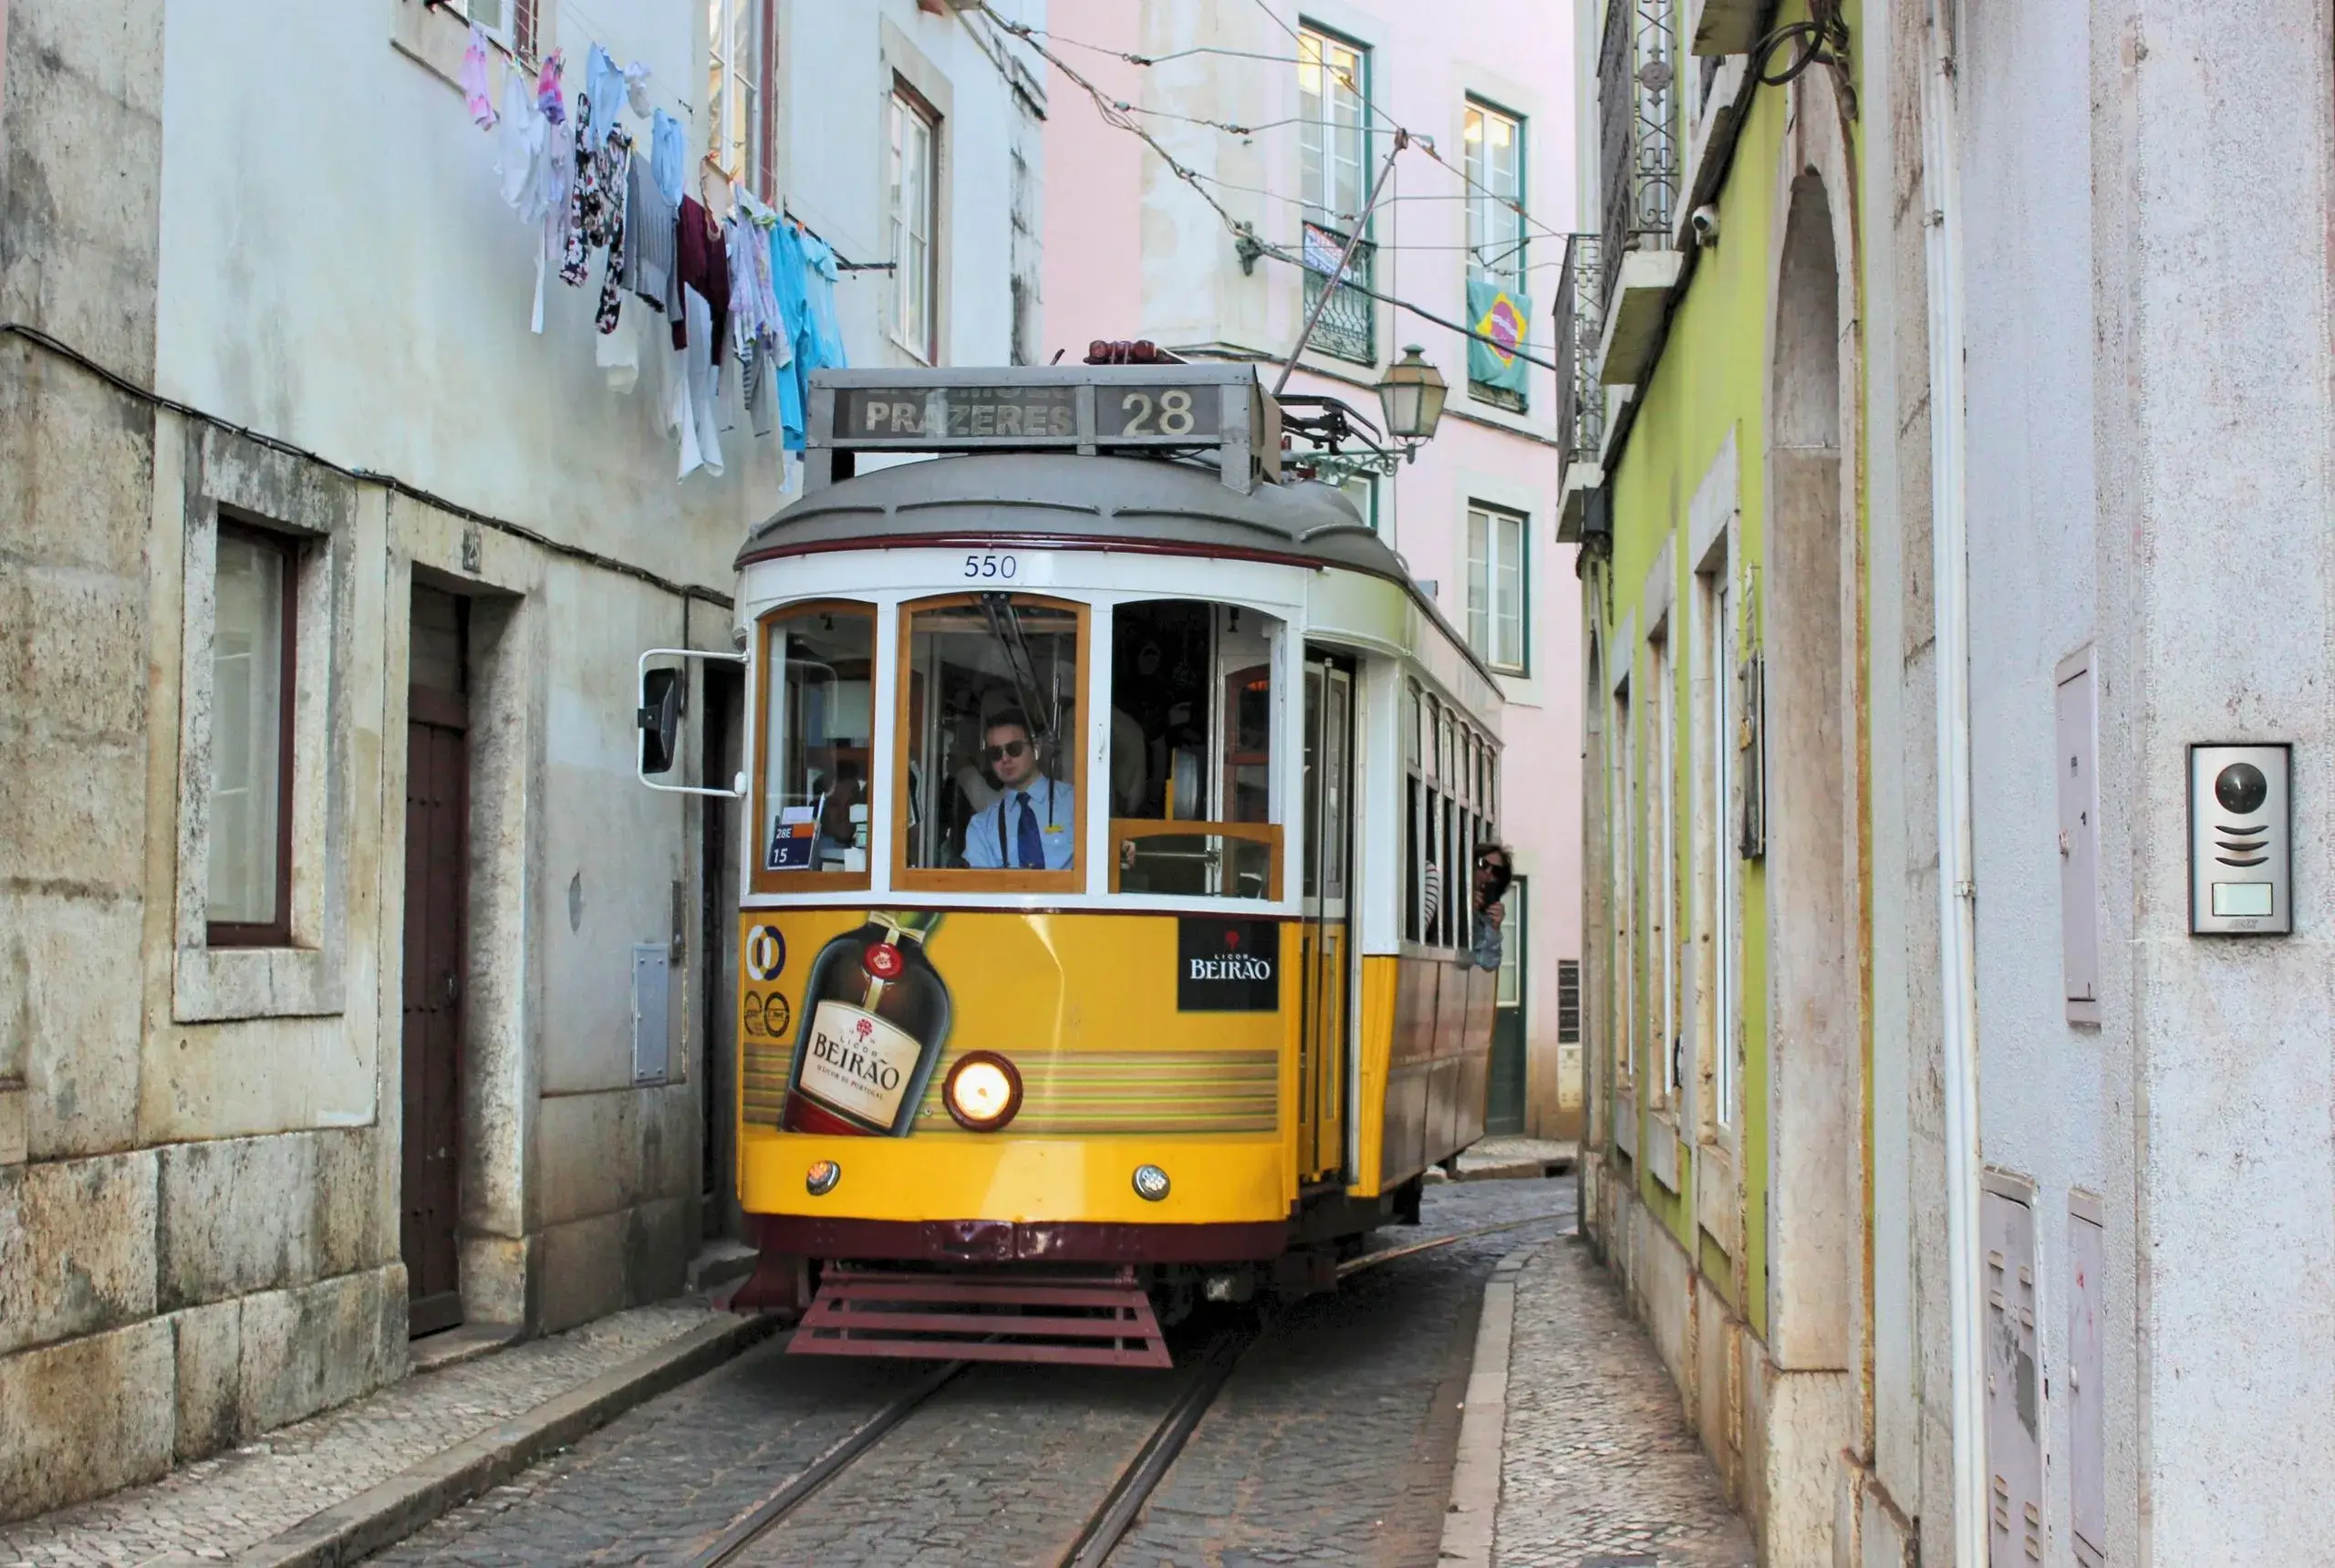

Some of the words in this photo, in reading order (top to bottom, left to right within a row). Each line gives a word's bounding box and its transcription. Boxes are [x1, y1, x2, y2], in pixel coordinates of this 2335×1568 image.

[866, 401, 1073, 436] PRAZERES
[1121, 389, 1195, 436] 28
[964, 555, 1017, 578] 550
[776, 828, 792, 839] 28E
[773, 848, 788, 863] 15
[1190, 958, 1271, 980] BEIRÃO
[840, 1035, 877, 1057] LICOR
[813, 1032, 900, 1091] BEIRÃO
